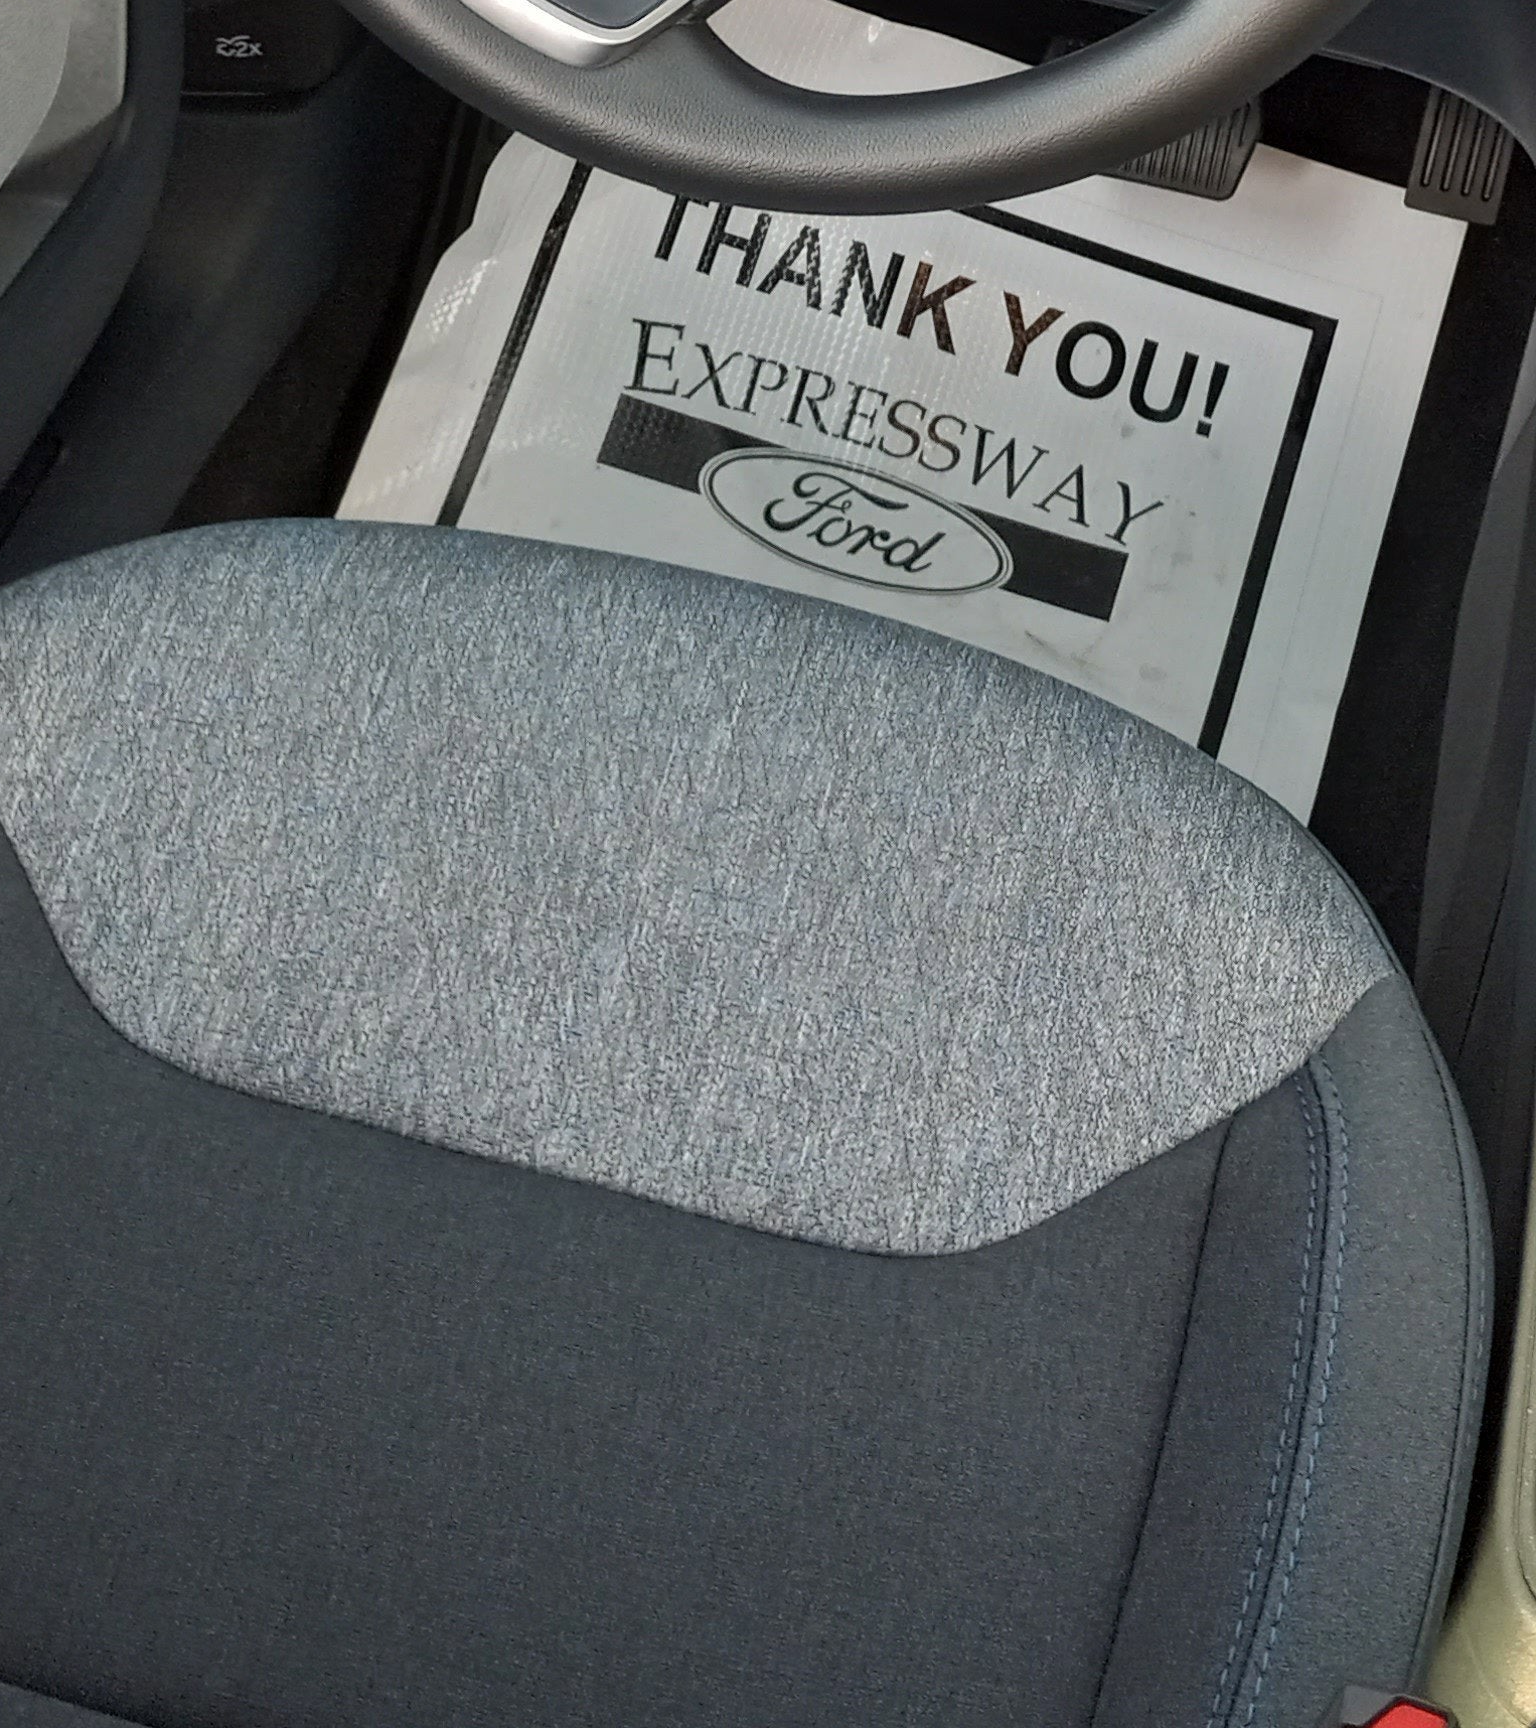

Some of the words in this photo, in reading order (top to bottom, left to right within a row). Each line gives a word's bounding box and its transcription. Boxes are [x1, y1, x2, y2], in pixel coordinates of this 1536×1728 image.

[622, 317, 1164, 548] EXPRESSWAY
[1000, 290, 1229, 437] YOU!
[762, 470, 934, 579] Ford
